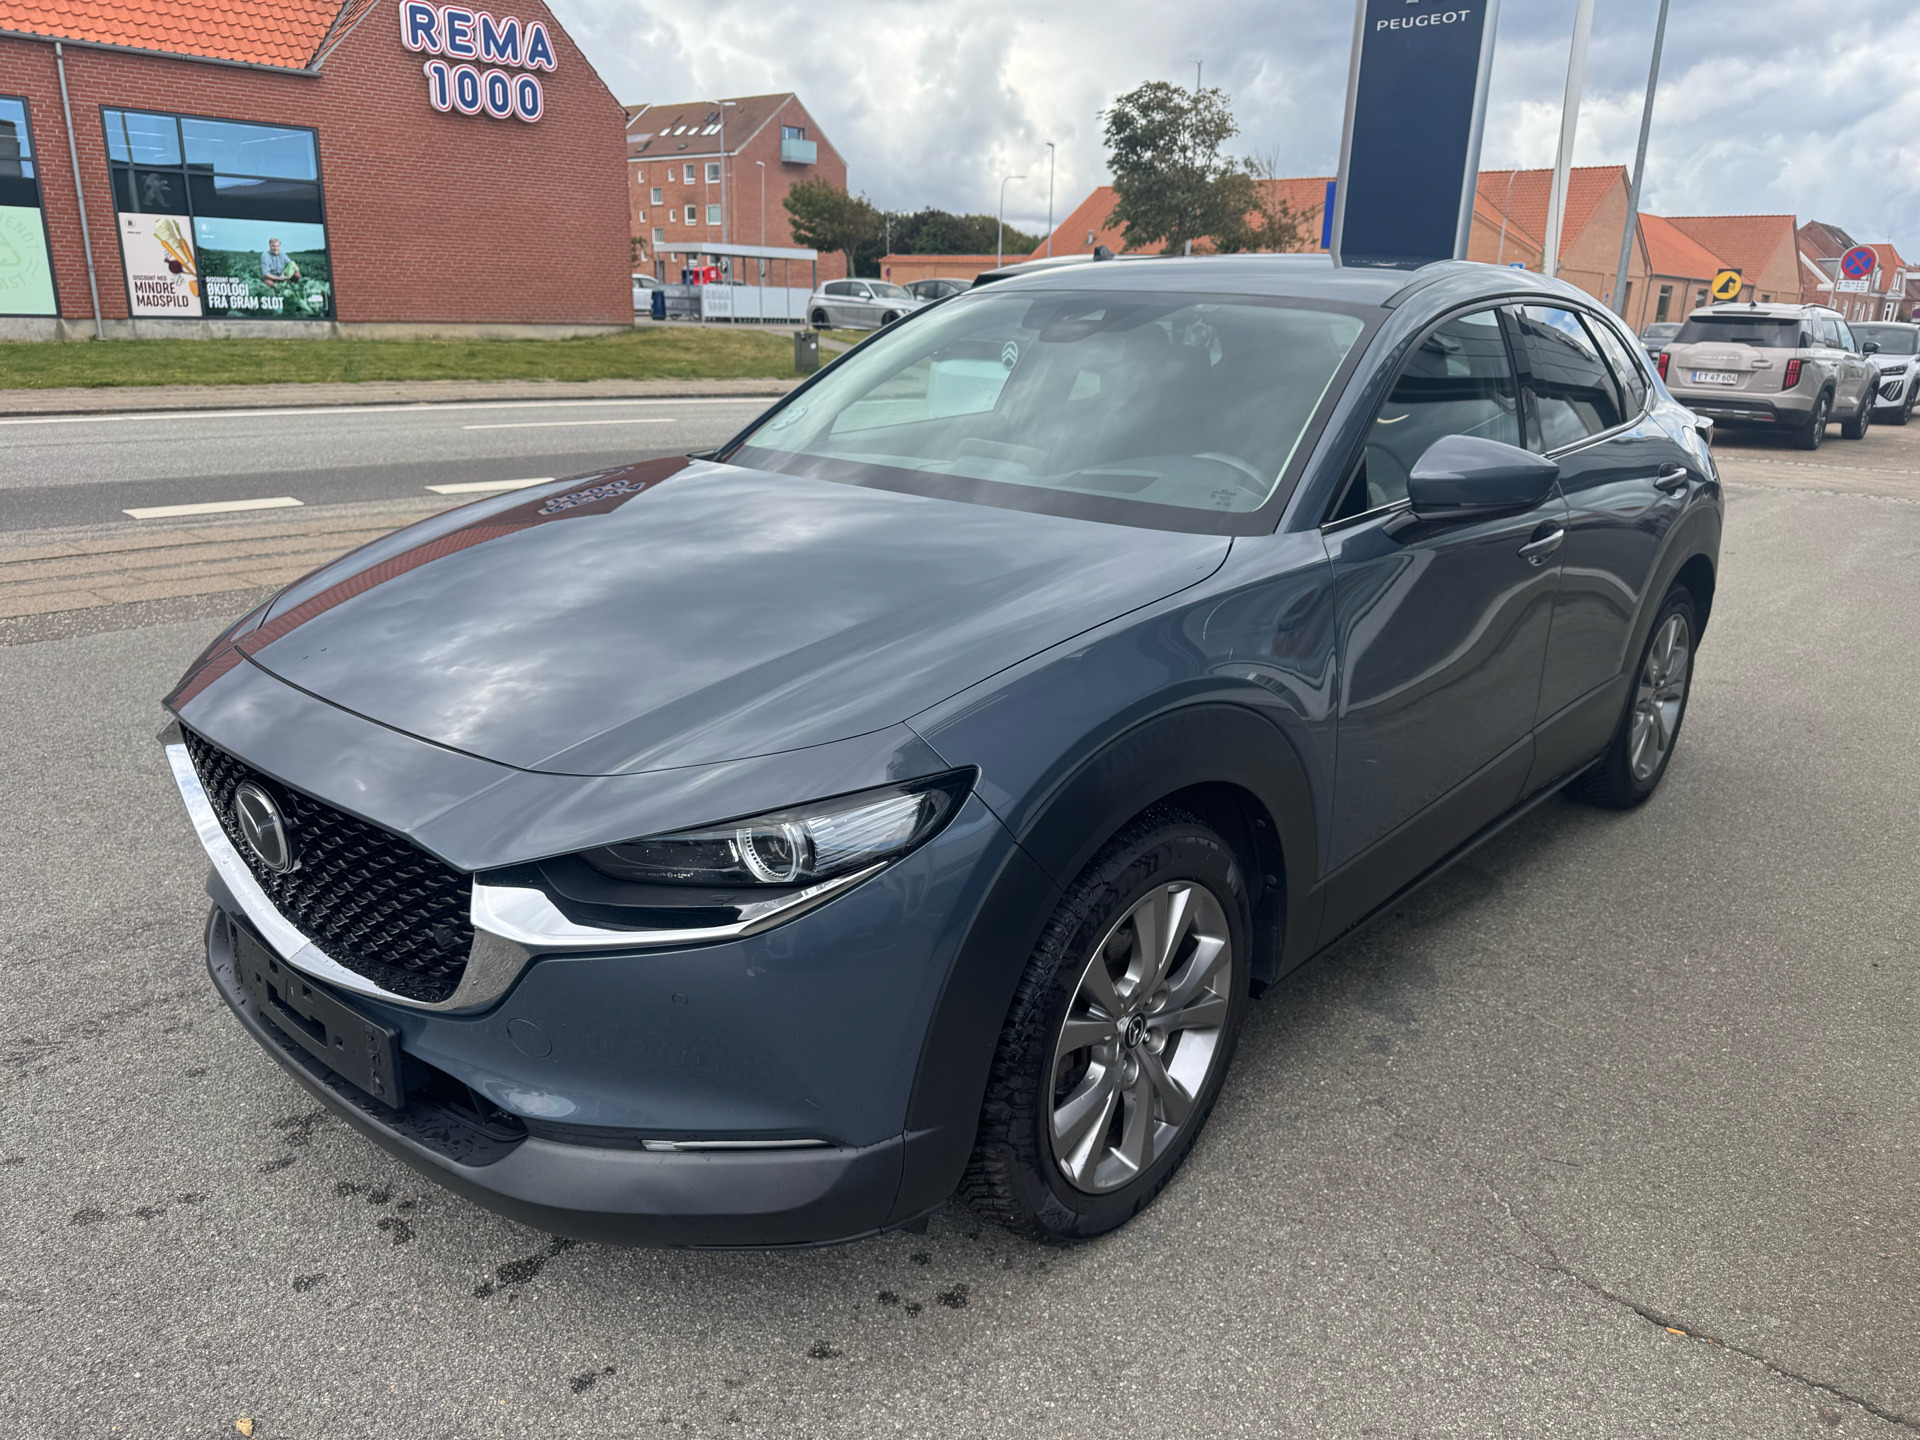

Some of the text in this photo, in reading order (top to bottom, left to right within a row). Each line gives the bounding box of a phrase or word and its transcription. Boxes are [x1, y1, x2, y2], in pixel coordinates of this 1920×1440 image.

[1377, 9, 1471, 32] PEUGEOT
[403, 1, 557, 71] REMA
[426, 61, 543, 120] 1000
[134, 281, 176, 295] MINDRE
[206, 282, 250, 297] ØKOLOGI
[136, 294, 189, 307] MADSPILD
[208, 295, 284, 310] FRA GRAM SLOT
[1709, 373, 1720, 381] 47
[1722, 374, 1737, 382] 604
